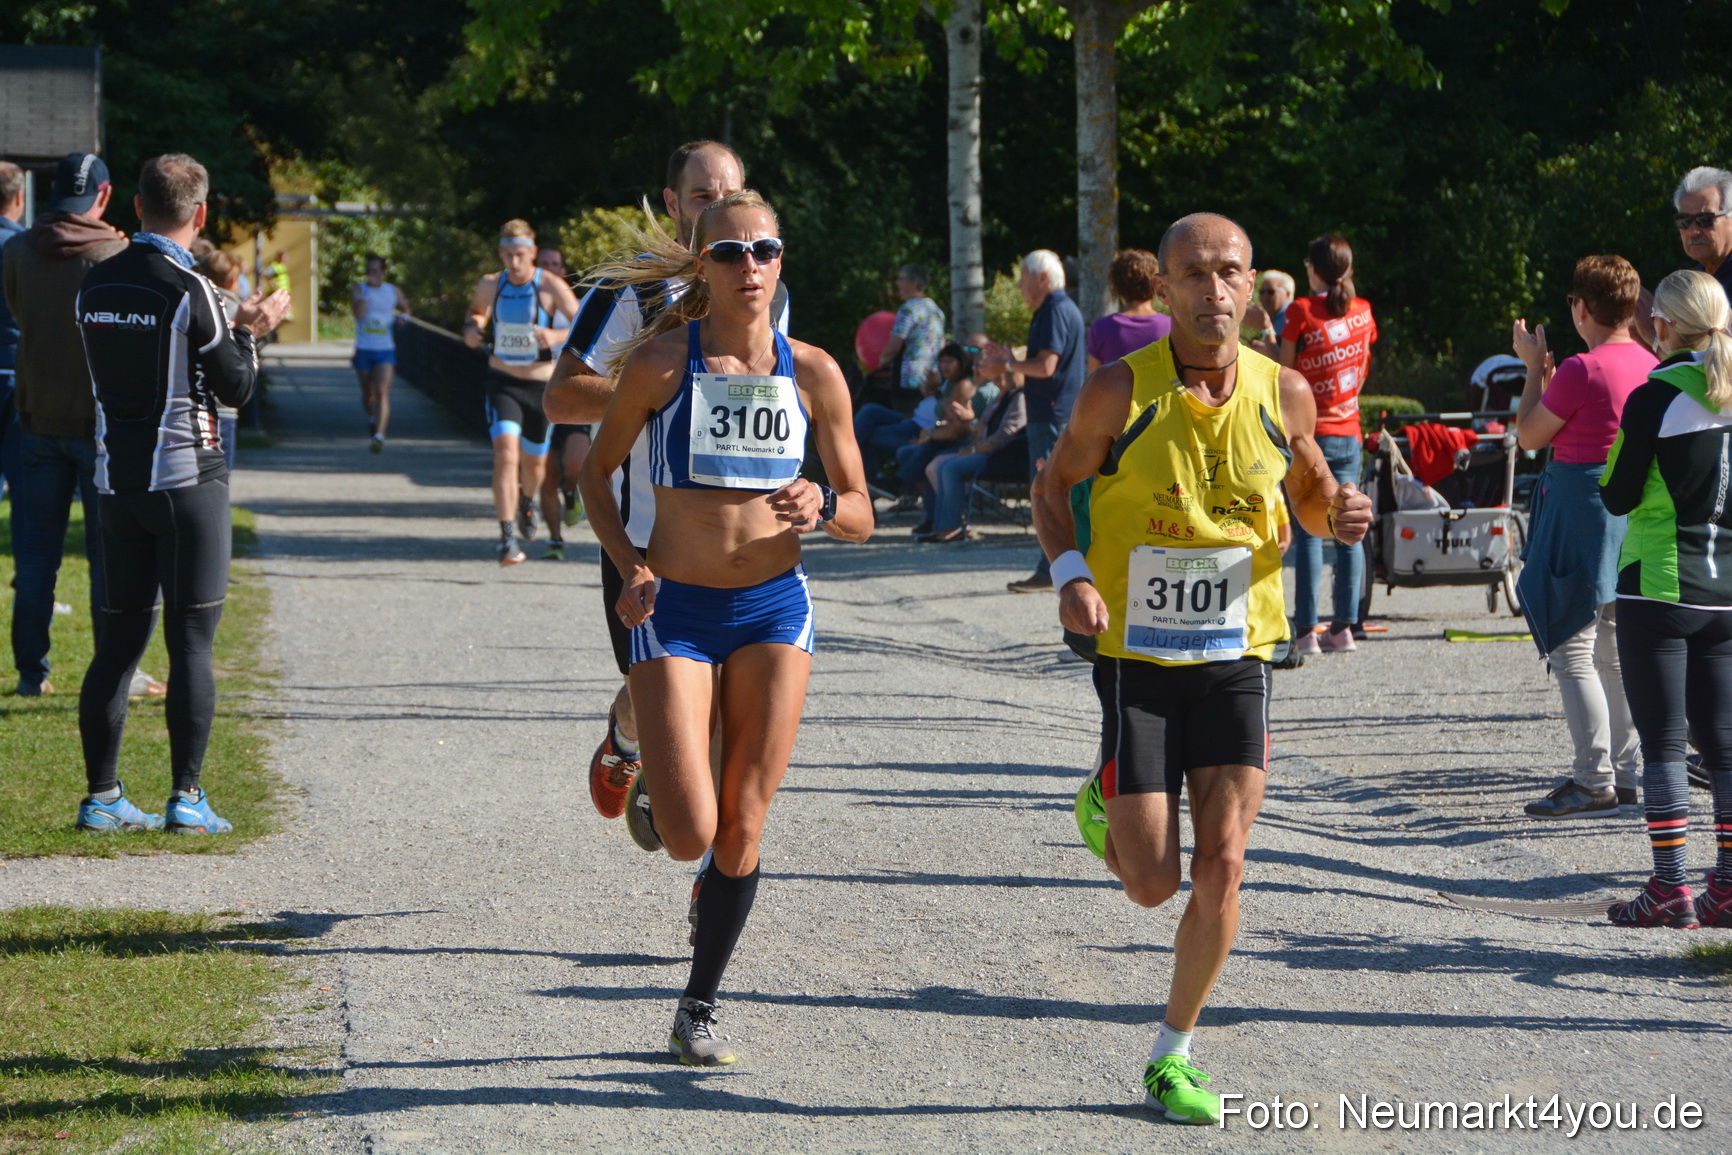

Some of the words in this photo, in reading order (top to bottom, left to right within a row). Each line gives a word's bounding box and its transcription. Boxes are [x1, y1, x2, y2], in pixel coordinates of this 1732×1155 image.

[501, 335, 531, 348] 2393
[728, 384, 780, 398] BOCK
[709, 405, 791, 442] 3100
[716, 444, 741, 453] PARTL
[742, 446, 775, 454] Neumarkt
[1149, 518, 1165, 532] M
[1167, 522, 1181, 536] &
[1185, 526, 1196, 539] S
[1166, 557, 1219, 570] BOCK
[1146, 577, 1229, 613] 3101
[1152, 615, 1178, 625] PARTL
[1180, 618, 1215, 626] Neumarkt
